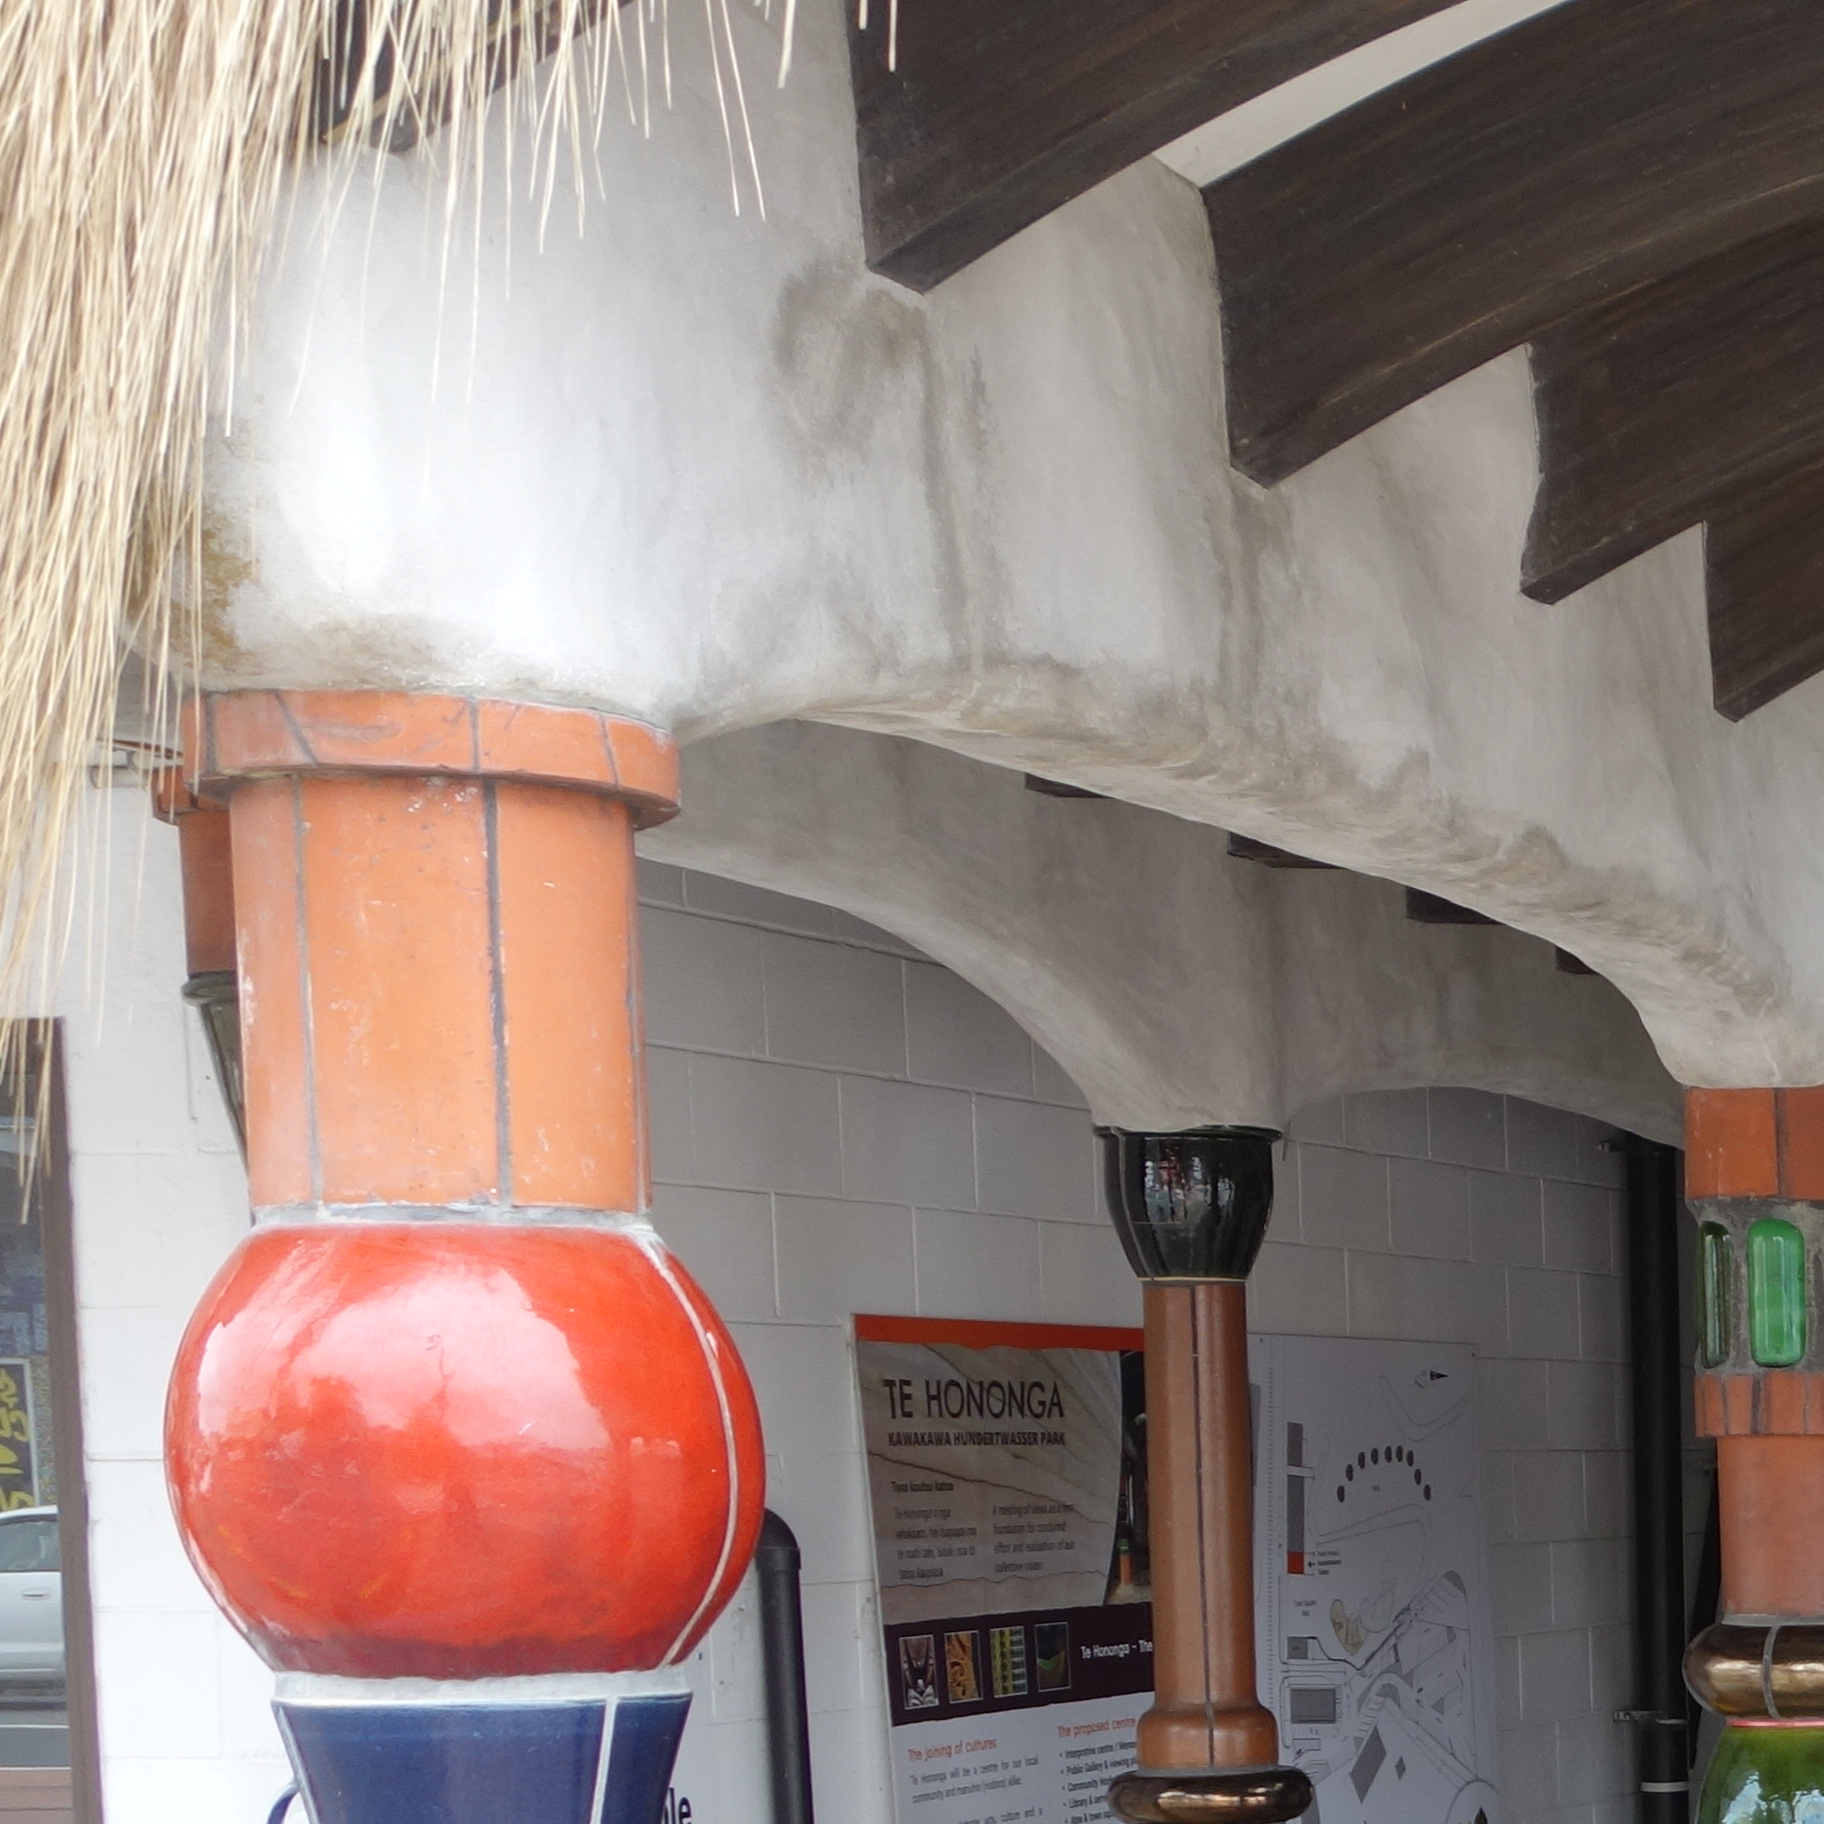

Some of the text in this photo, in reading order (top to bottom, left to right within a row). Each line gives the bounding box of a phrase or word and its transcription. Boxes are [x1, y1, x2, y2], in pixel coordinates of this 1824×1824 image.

[882, 1378, 1065, 1420] TE HONONGA
[888, 1431, 1066, 1447] KAWAKAWA HUNDERTWASSER PARK
[1080, 1645, 1092, 1659] Te
[1092, 1643, 1130, 1658] Hononga
[1057, 1724, 1072, 1738] The
[1073, 1720, 1109, 1738] proposed
[908, 1738, 998, 1762] The joining of cultures
